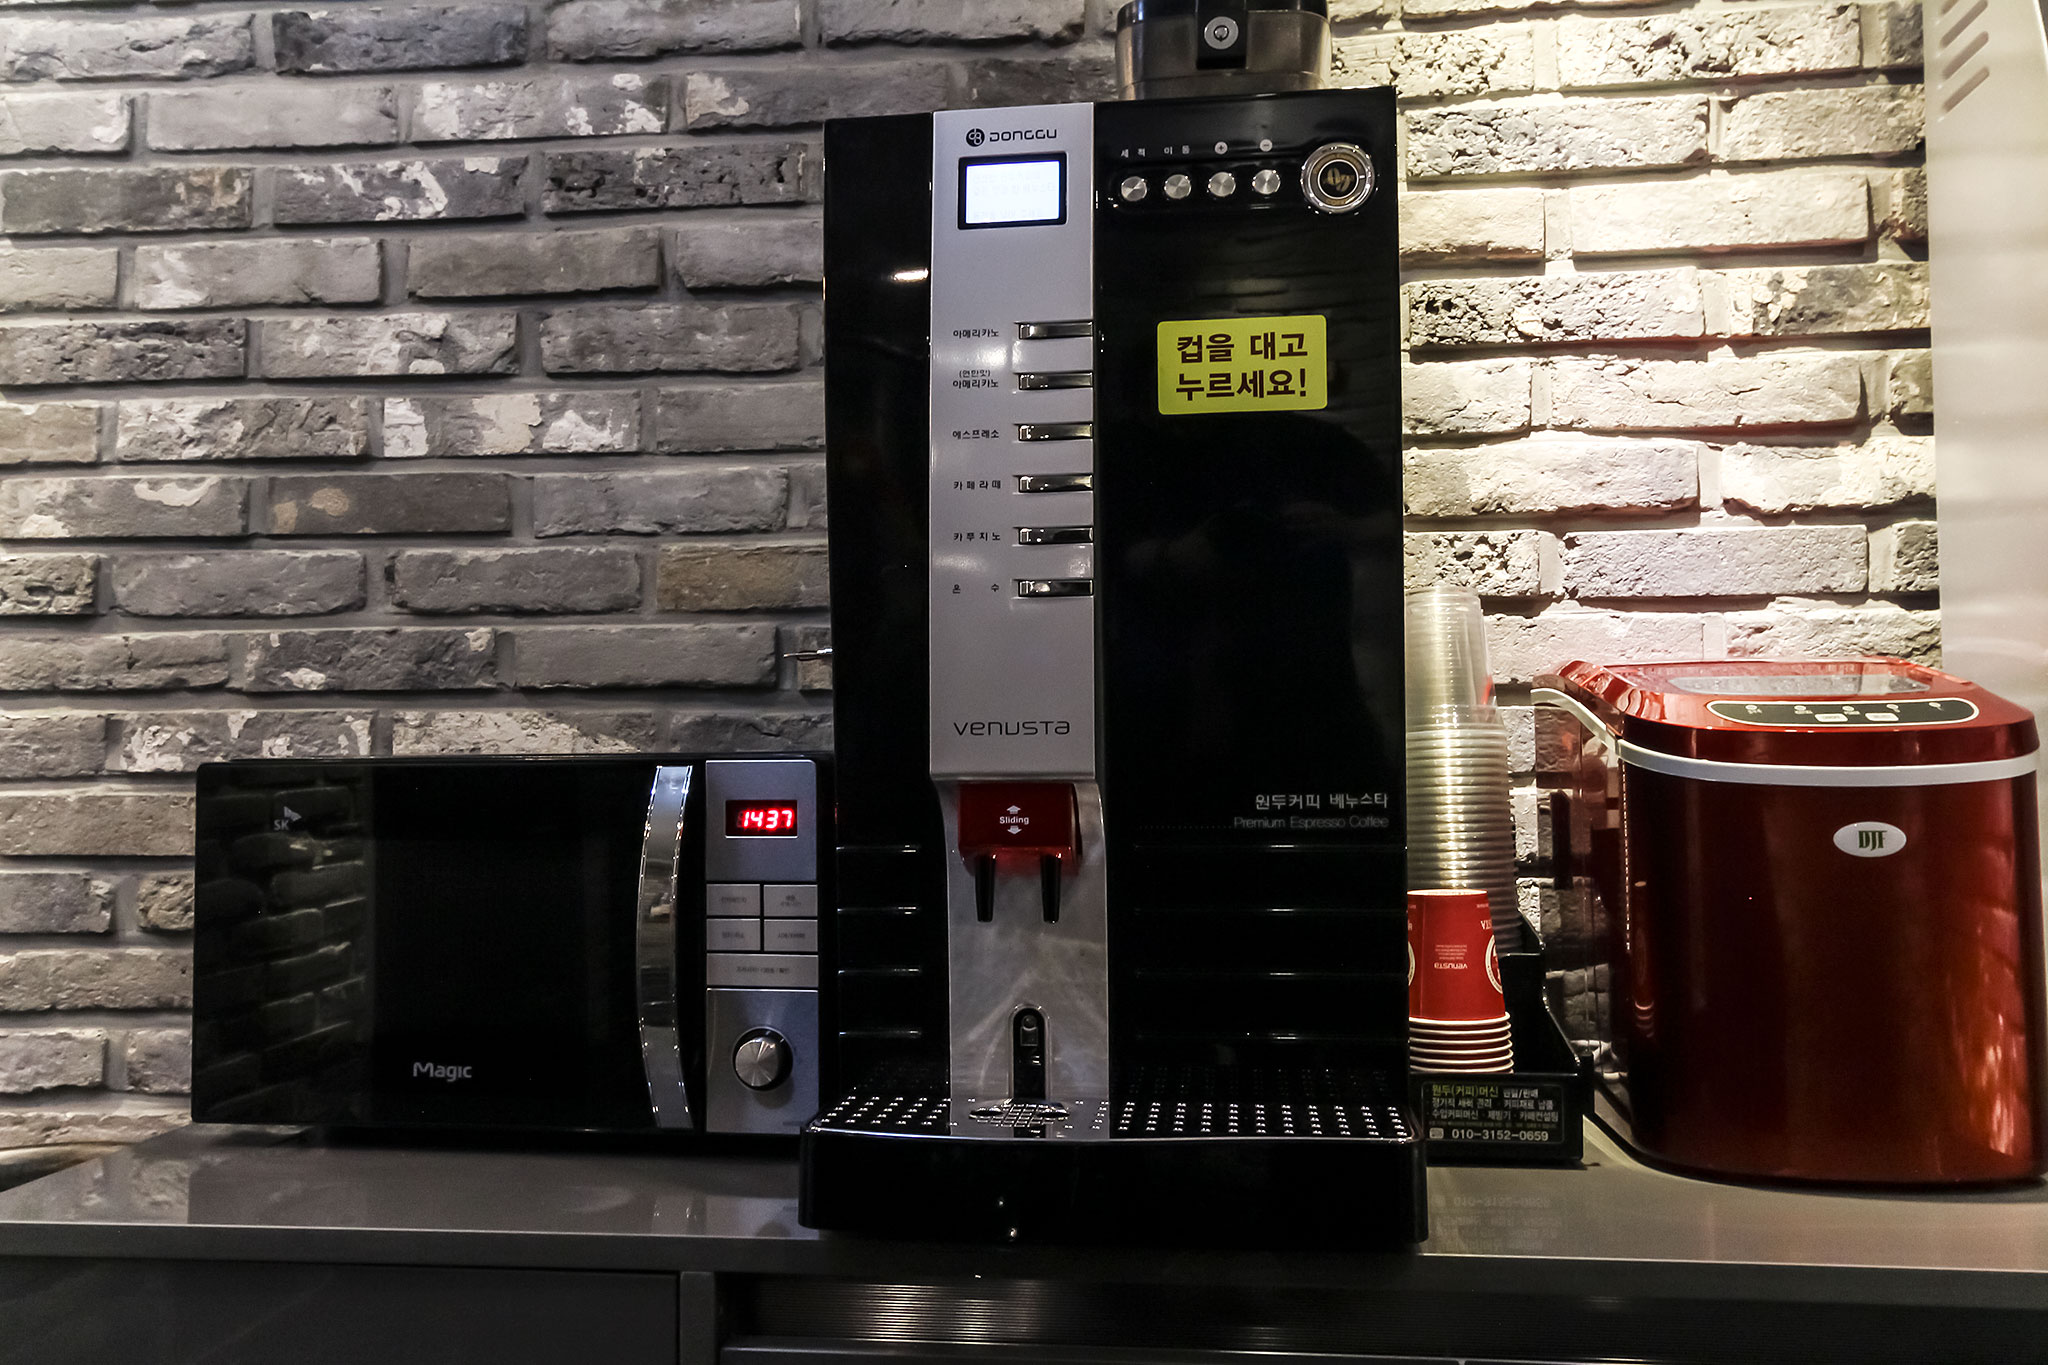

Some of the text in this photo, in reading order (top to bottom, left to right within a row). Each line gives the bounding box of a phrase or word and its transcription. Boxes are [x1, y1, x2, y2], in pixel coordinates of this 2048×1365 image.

[989, 129, 1057, 142] DONGGU
[953, 328, 999, 339] 아메리카노
[1176, 331, 1308, 364] 컵을 대고
[953, 379, 999, 389] 아메리카노
[1175, 368, 1307, 401] 누르세요!
[952, 429, 1000, 440] 에스프레소
[1255, 792, 1388, 810] 원두커피 베누스타
[273, 818, 290, 831] SK
[743, 809, 794, 829] 1437
[999, 816, 1030, 825] Sliding
[1234, 815, 1389, 830] Premium Espresso Coffee
[412, 1061, 473, 1083] Magic
[1431, 1084, 1499, 1098] 원두(커피)머신
[1451, 1128, 1550, 1142] 010-3152-0659
